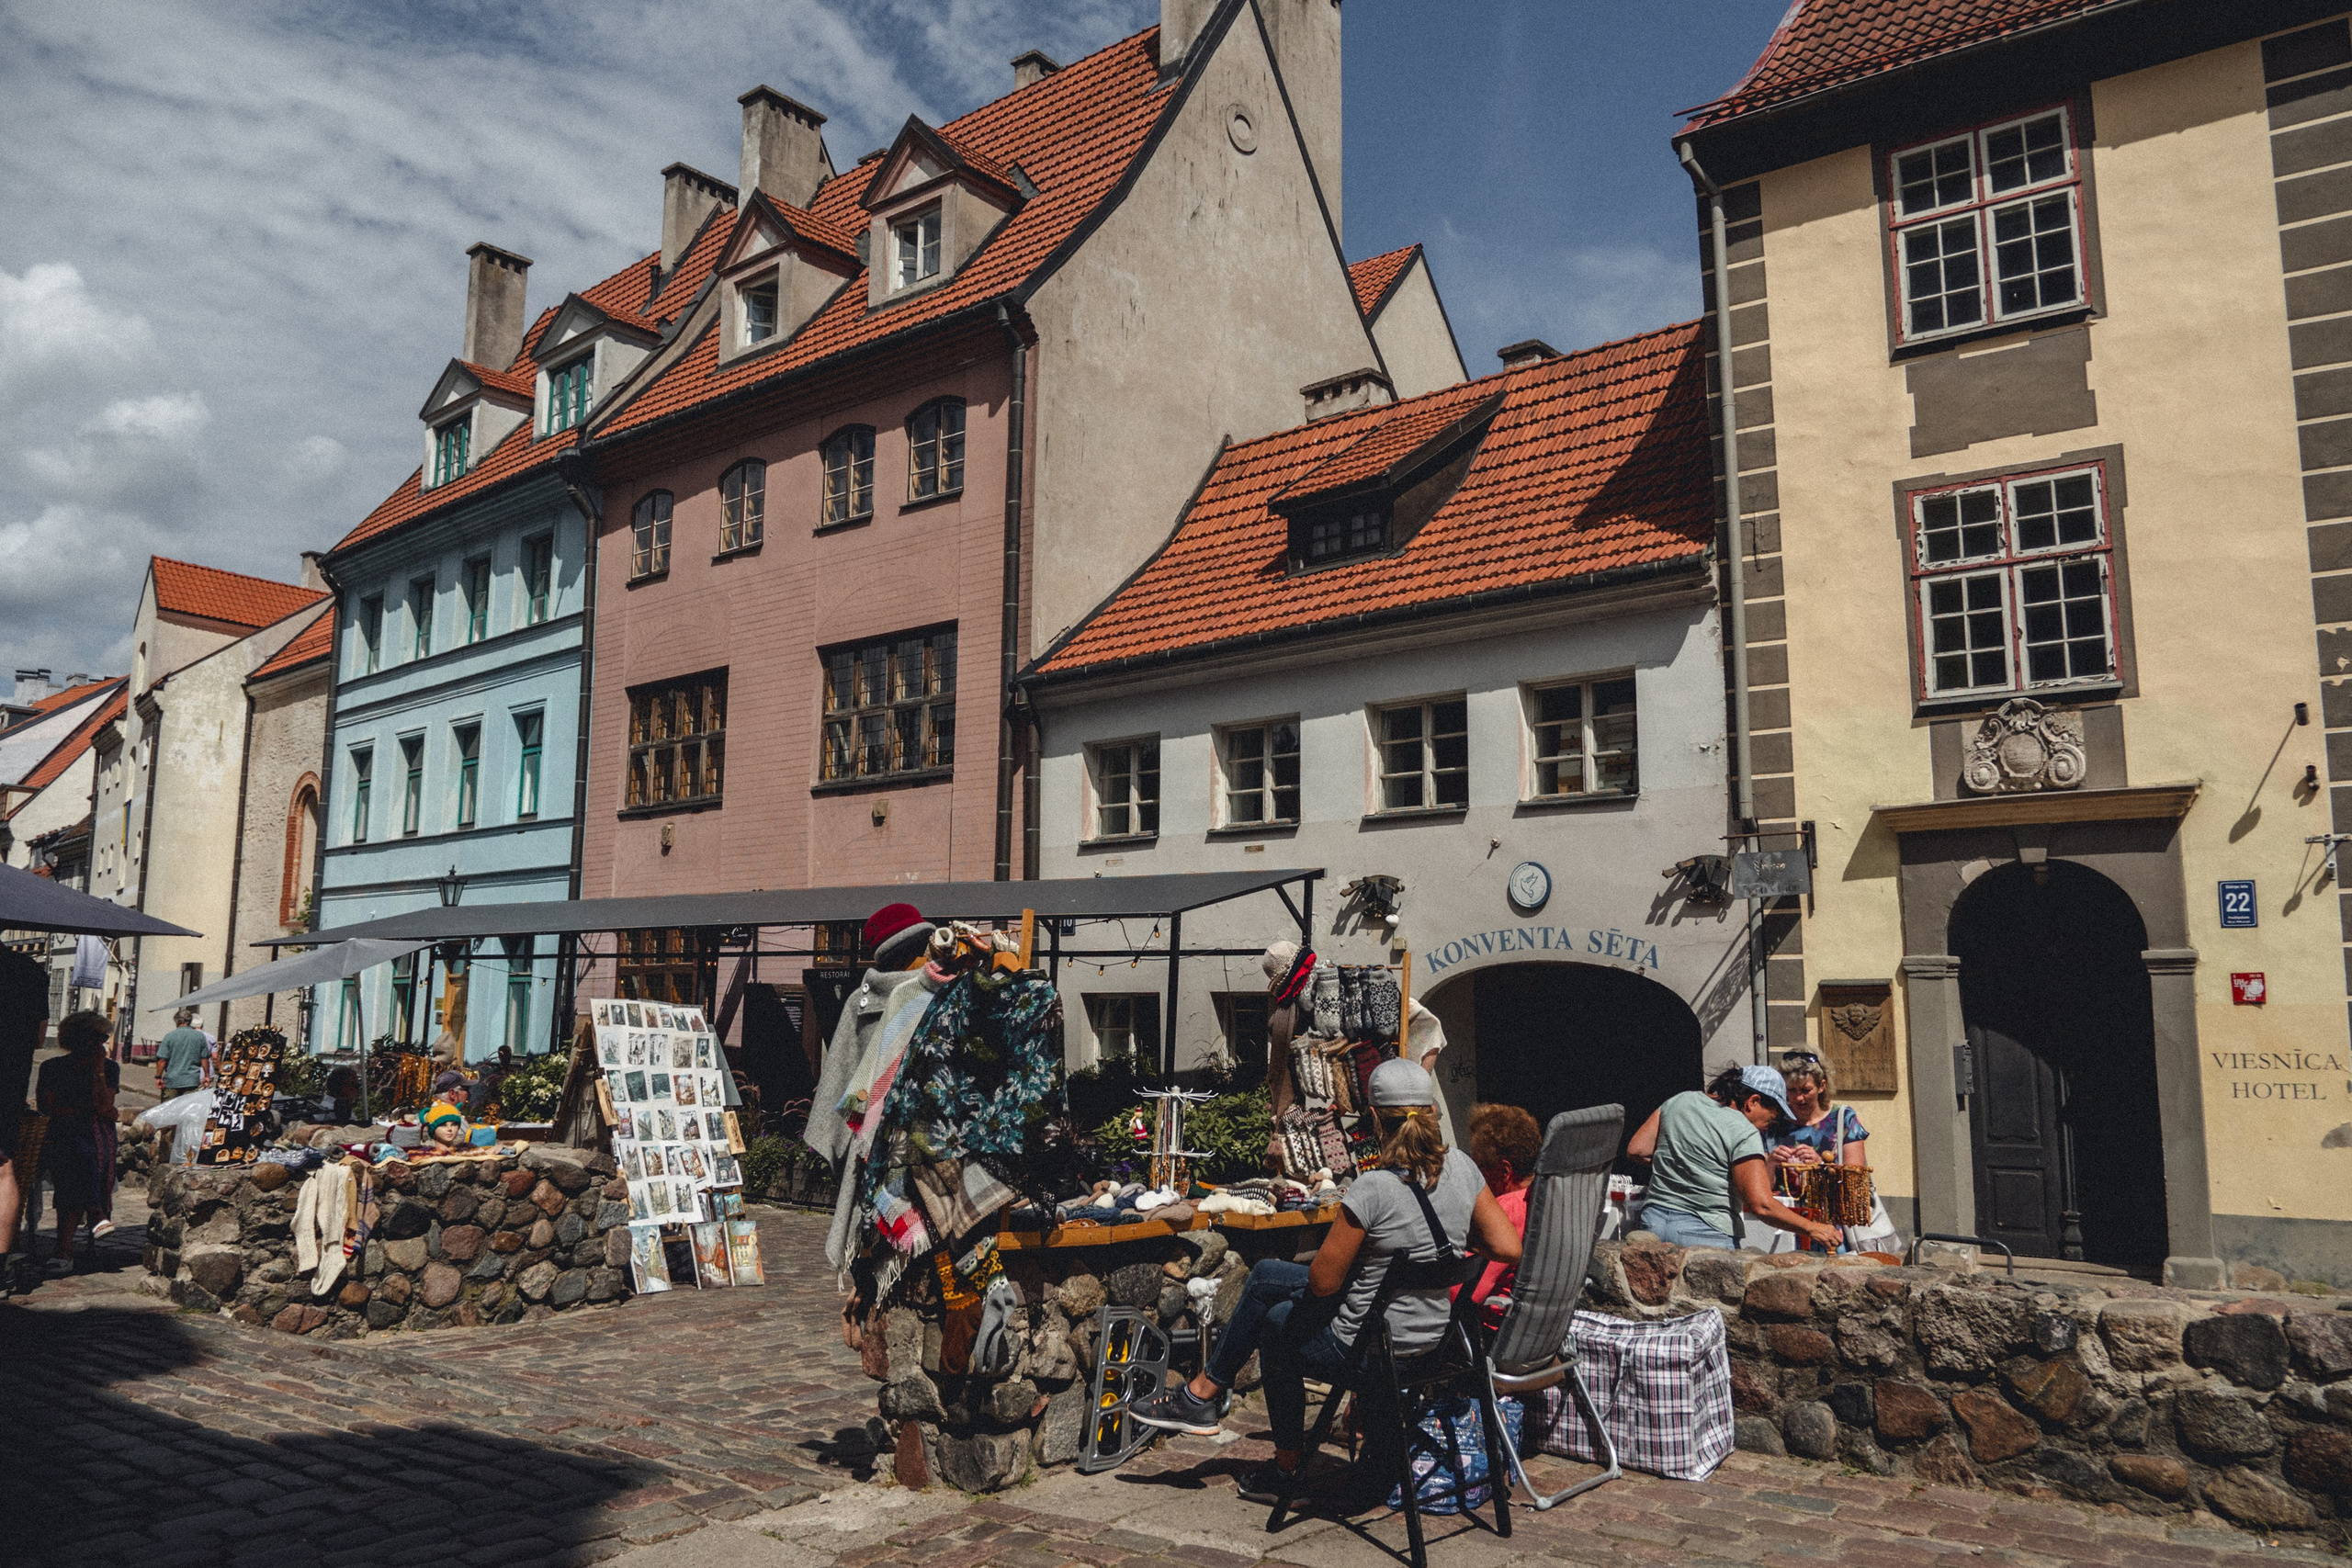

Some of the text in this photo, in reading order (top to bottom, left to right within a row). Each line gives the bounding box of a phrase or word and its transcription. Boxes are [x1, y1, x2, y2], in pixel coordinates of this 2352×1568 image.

[2225, 892, 2251, 912] 22
[1425, 926, 1658, 974] KONVENTA SĒTA
[2211, 1049, 2342, 1071] VIESNĪCA
[2232, 1082, 2327, 1100] HOTEL
